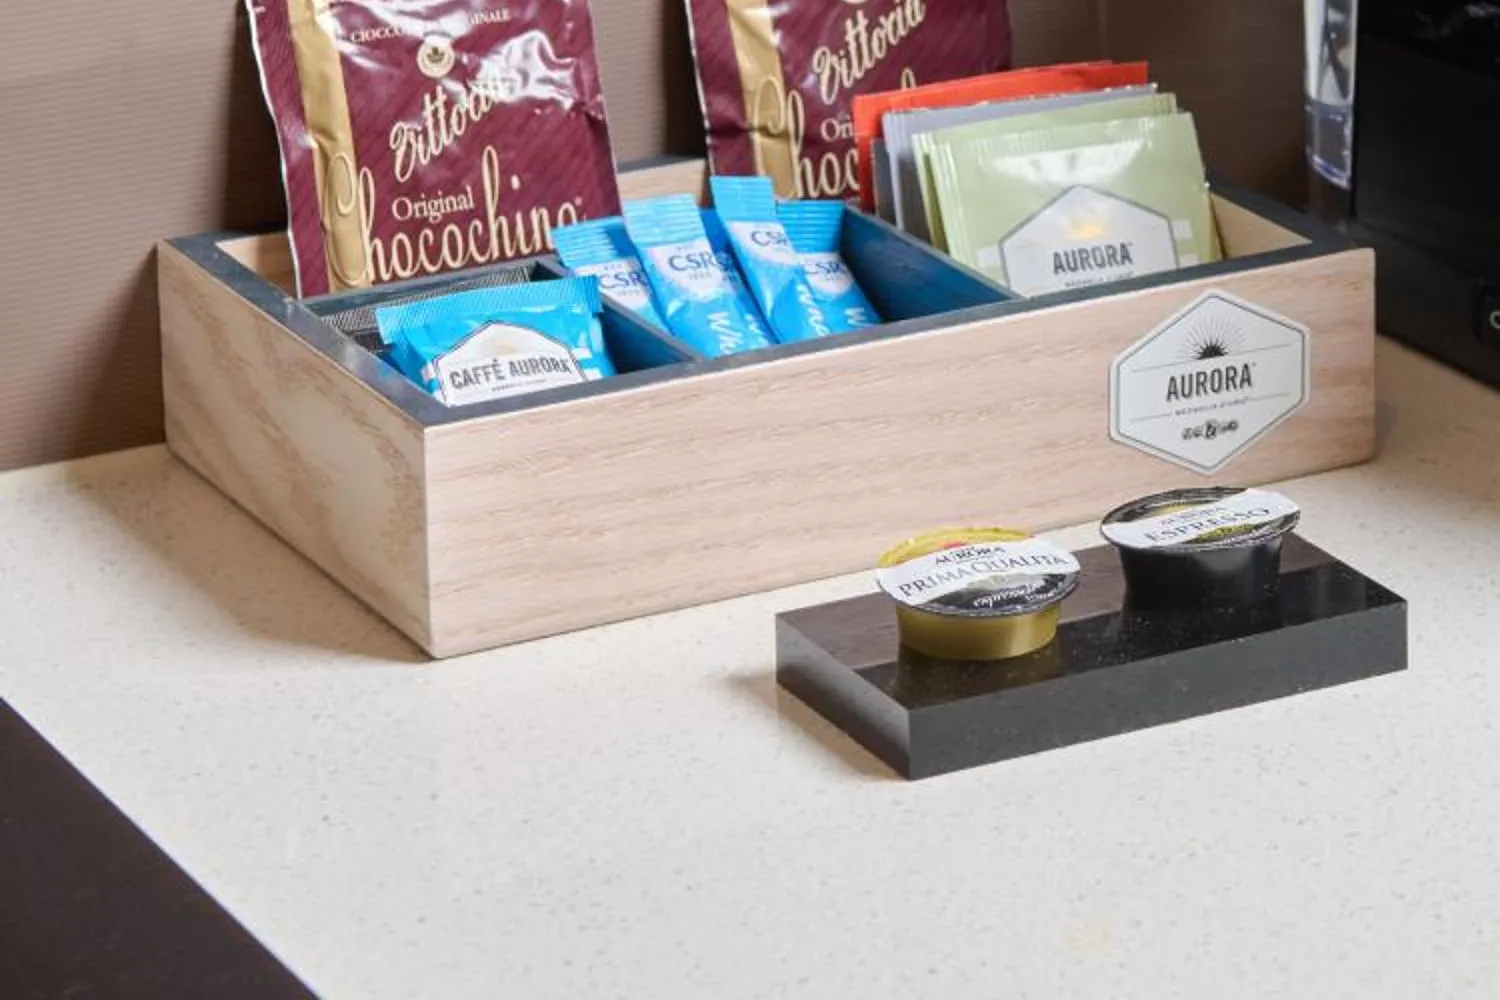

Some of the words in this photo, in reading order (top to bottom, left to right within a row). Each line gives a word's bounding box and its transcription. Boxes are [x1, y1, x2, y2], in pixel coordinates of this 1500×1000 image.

[391, 184, 475, 225] Original
[668, 251, 715, 272] CSR
[1053, 242, 1133, 275] AURORA
[449, 358, 506, 390] CAFFÉ
[508, 357, 571, 377] AURORA
[1166, 363, 1253, 402] AURORA
[1143, 507, 1270, 543] ESPRESSO
[898, 568, 971, 598] PRIMA
